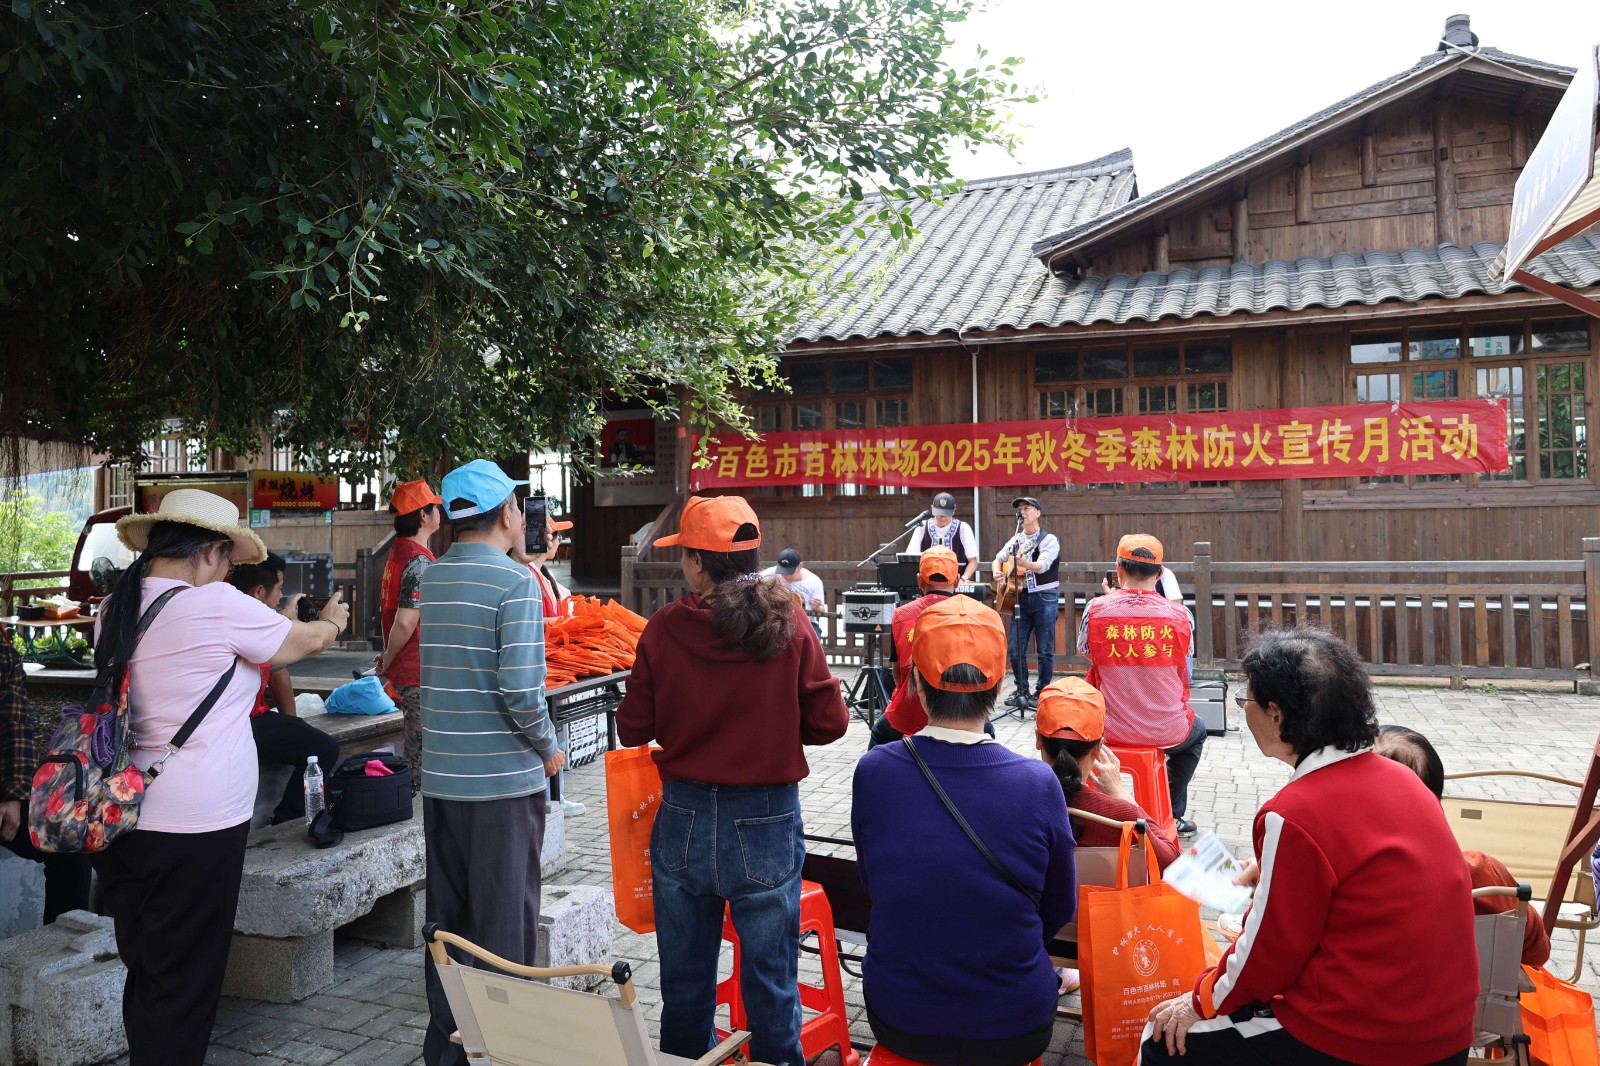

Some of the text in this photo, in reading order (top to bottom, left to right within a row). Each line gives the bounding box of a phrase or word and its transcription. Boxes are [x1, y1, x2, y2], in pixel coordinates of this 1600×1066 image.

[716, 413, 1479, 479] 百色市百林林场2025年秋冬季森林防火宣传月活动
[1105, 624, 1174, 640] 森林防火
[1107, 643, 1174, 658] 人人参与
